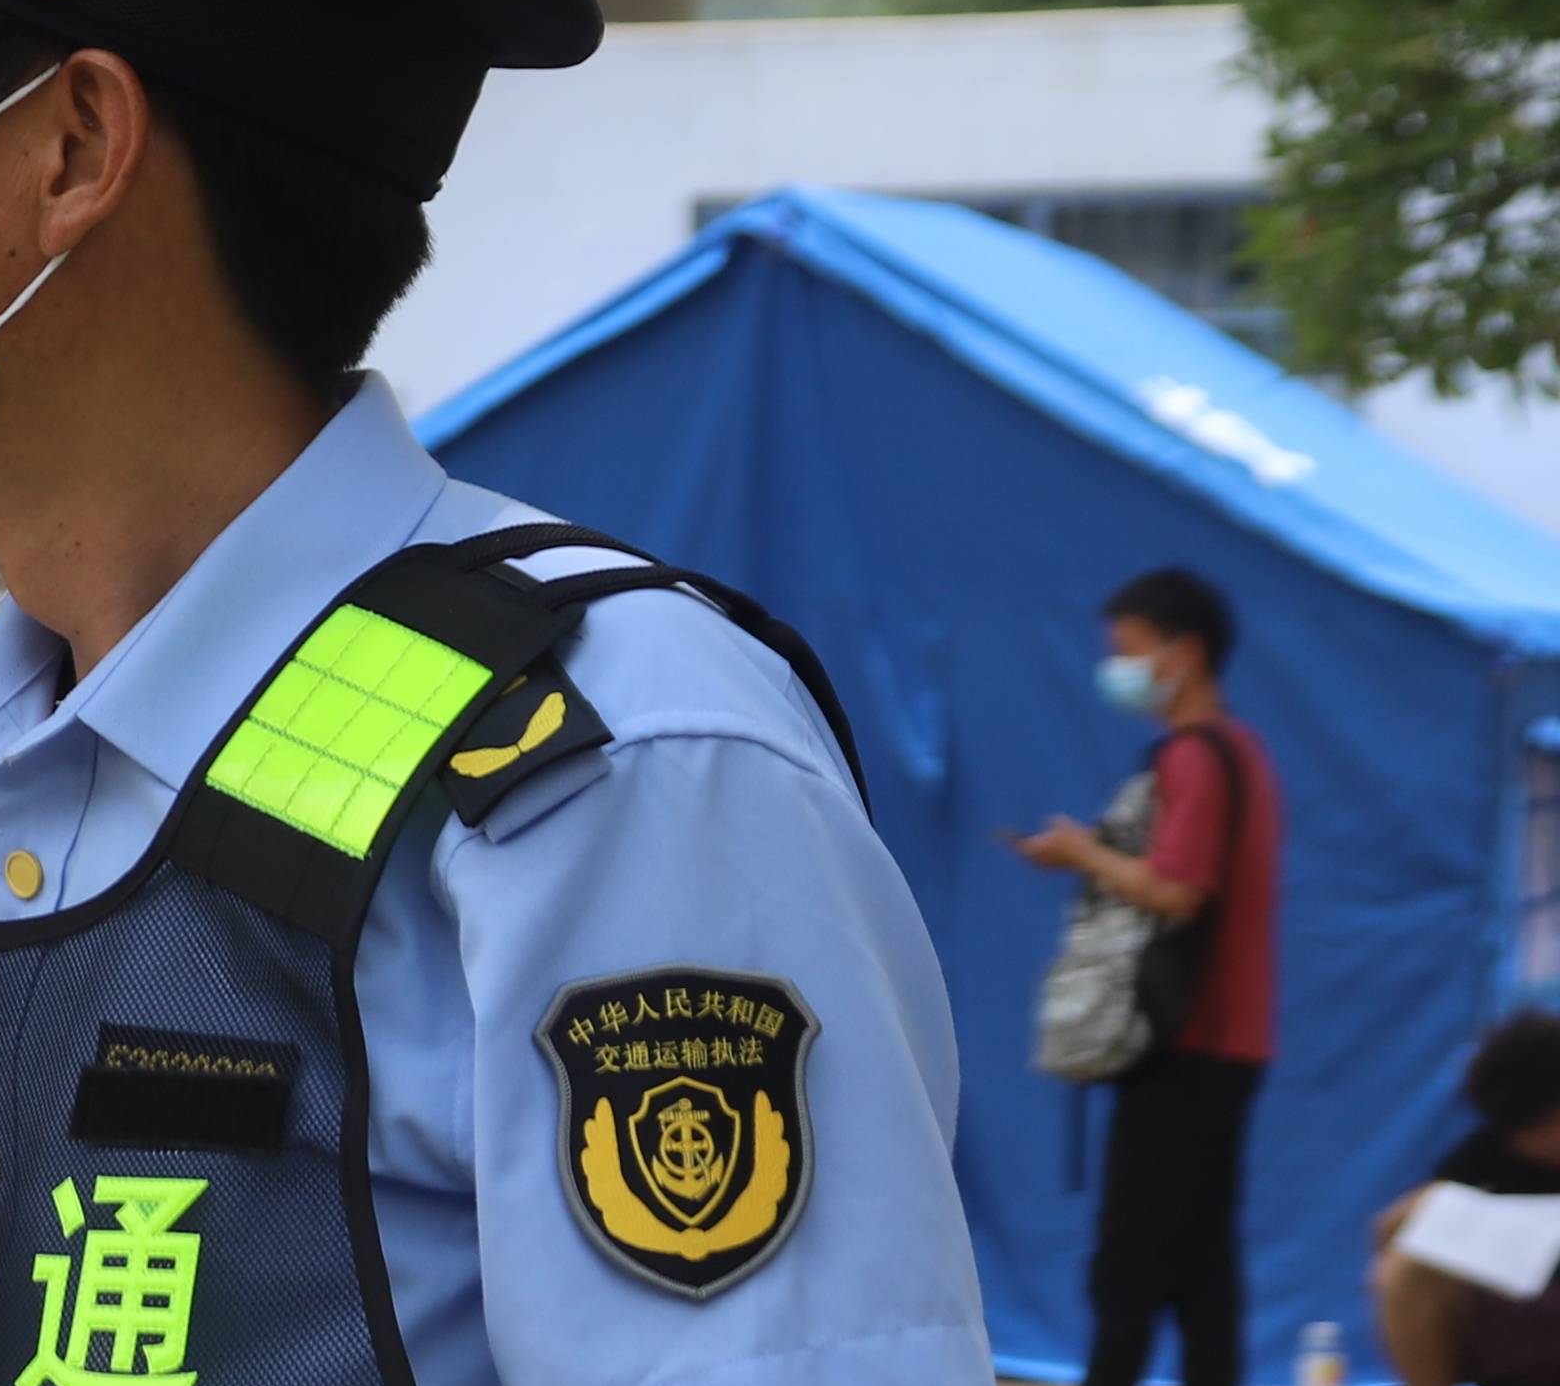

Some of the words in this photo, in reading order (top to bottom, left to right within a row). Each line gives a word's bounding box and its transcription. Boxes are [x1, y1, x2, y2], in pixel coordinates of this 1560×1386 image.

[568, 988, 785, 1047] 中华人民共和国
[593, 1035, 764, 1074] 交通运输执法
